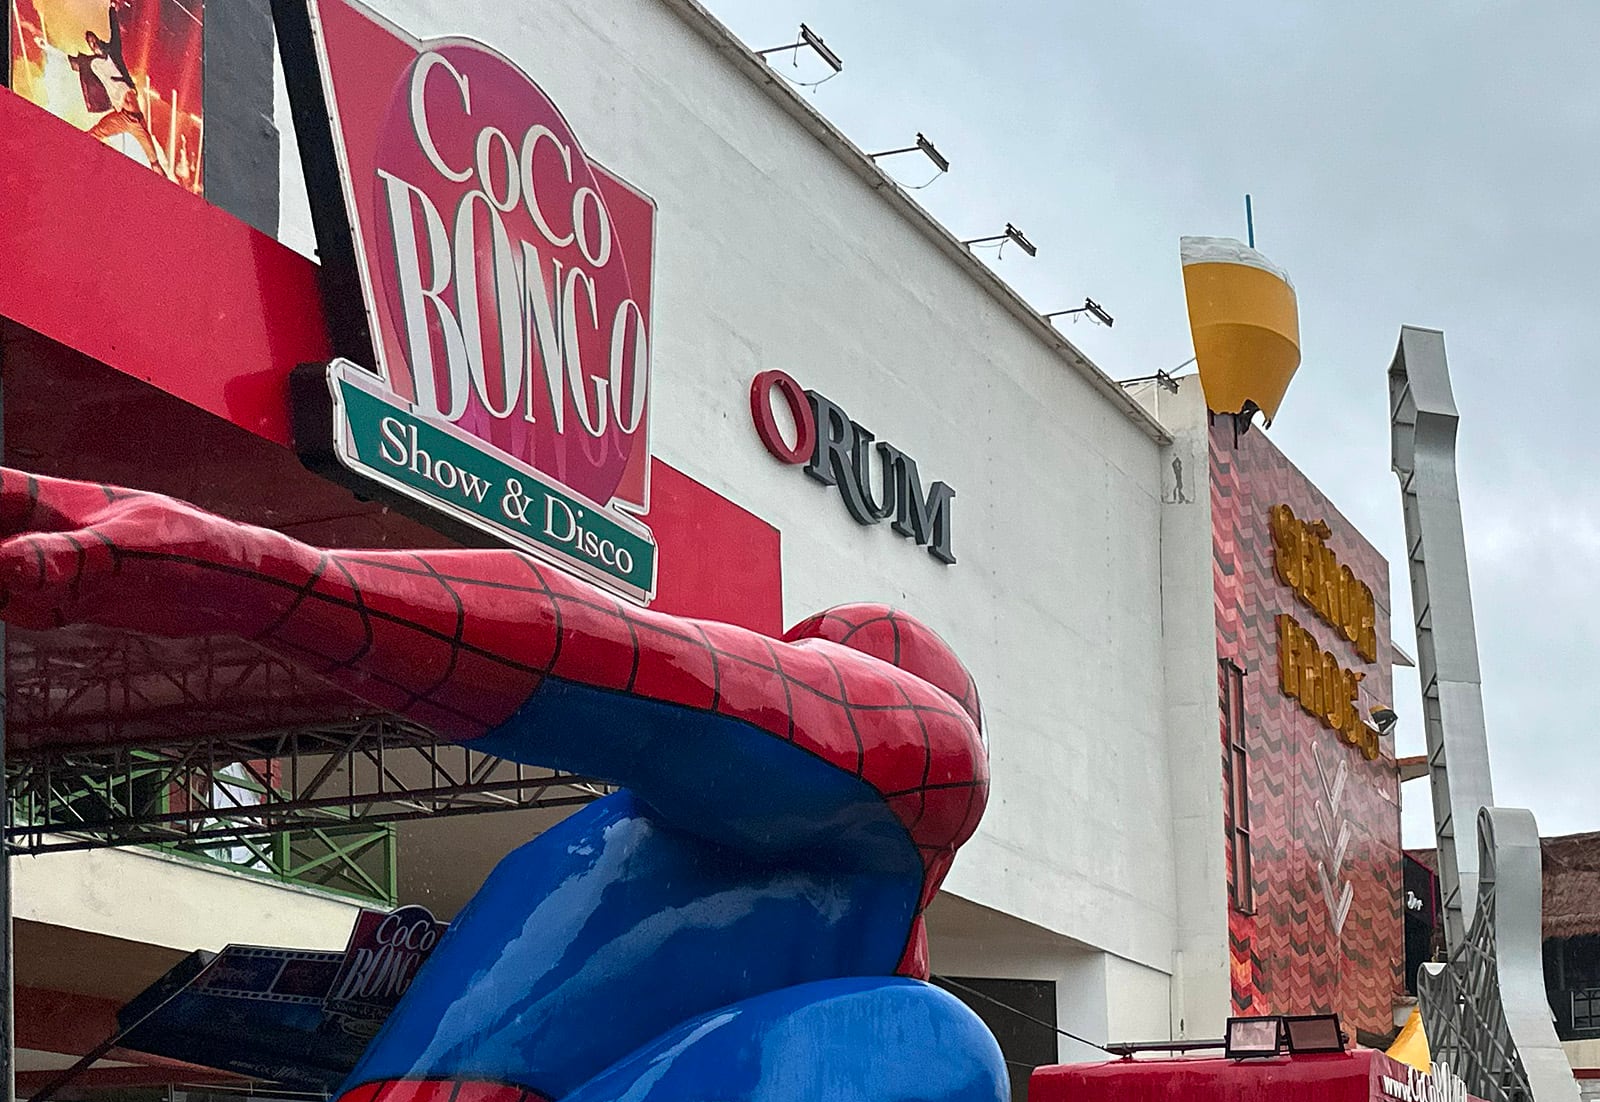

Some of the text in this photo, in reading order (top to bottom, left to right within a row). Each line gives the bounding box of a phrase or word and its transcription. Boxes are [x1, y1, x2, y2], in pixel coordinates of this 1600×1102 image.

[377, 168, 648, 438] BONGO
[379, 415, 636, 578] Show & Disco
[749, 369, 957, 564] ORUM
[339, 945, 421, 1001] BONG
